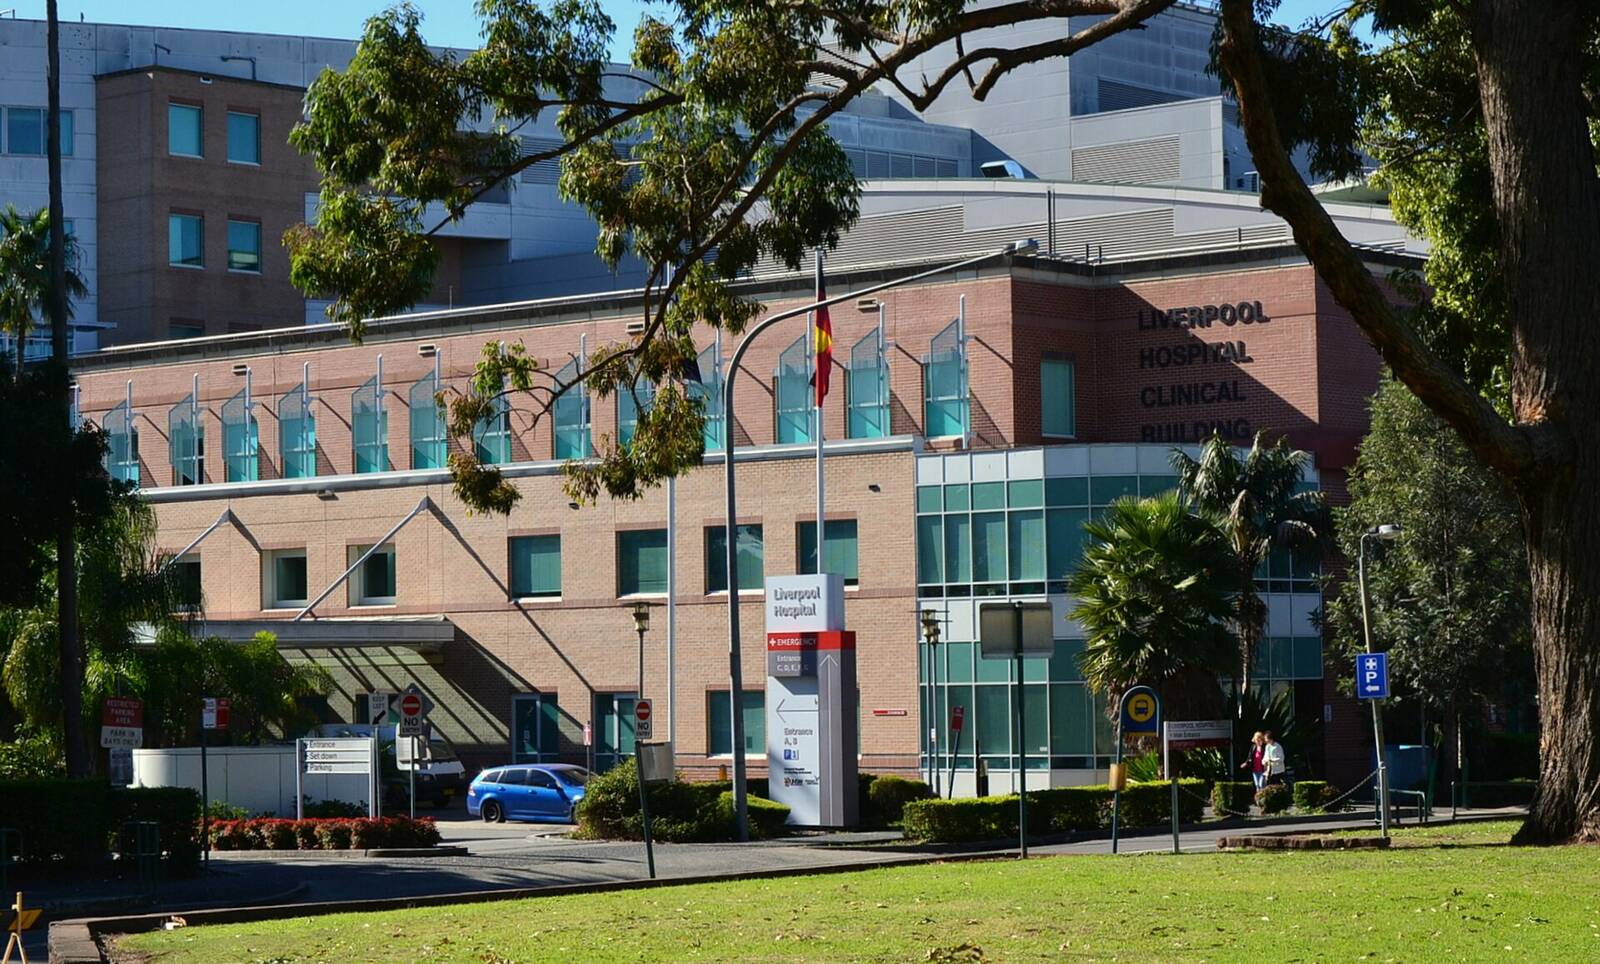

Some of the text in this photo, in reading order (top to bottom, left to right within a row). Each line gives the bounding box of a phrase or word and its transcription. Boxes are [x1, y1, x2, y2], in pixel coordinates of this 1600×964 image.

[1138, 301, 1270, 330] LIVERPOOL
[1140, 341, 1253, 369] HOSPITAL
[1140, 381, 1246, 407] CLINICAL
[1141, 417, 1250, 443] BUILDING
[774, 586, 821, 603] Liverpool
[774, 603, 816, 619] Hospital
[1366, 672, 1377, 683] P
[404, 718, 419, 727] NO
[638, 722, 649, 730] NO
[309, 740, 335, 748] Entrance
[309, 752, 338, 760] Set down
[309, 763, 333, 772] Parking
